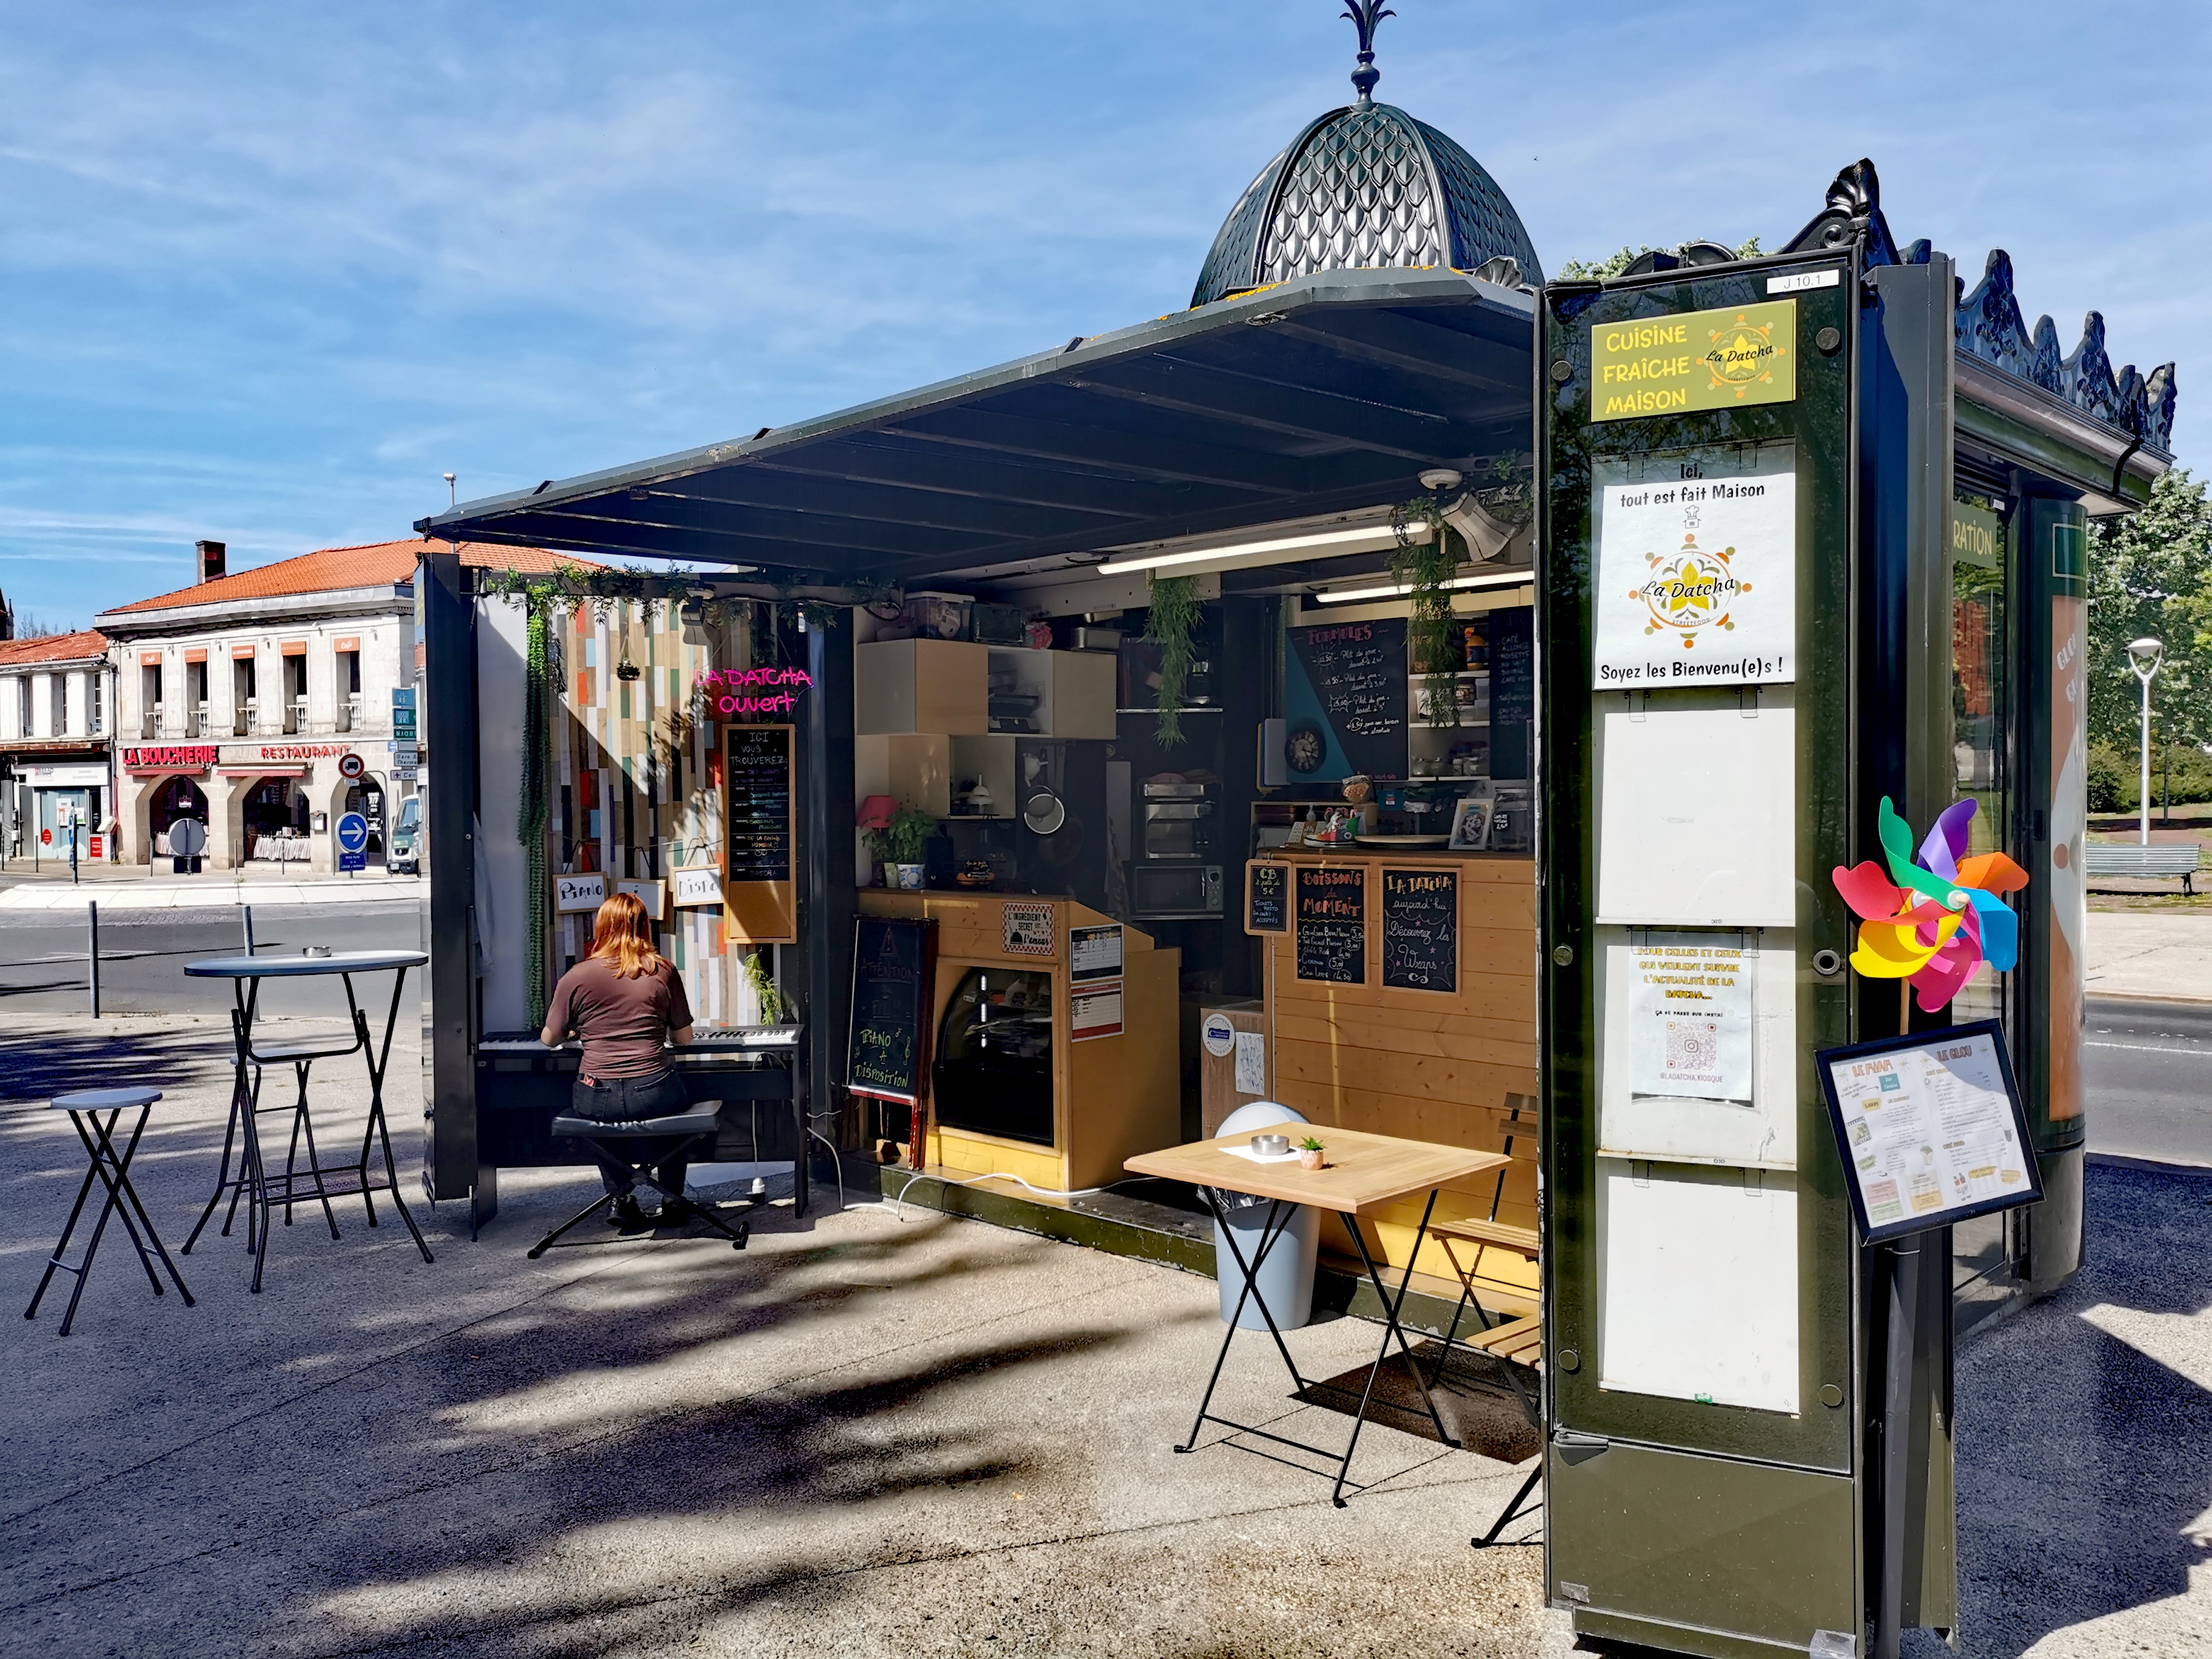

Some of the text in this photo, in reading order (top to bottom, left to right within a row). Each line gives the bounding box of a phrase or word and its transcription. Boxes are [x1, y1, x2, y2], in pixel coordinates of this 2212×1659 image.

[1783, 275, 1821, 289] J 10.1
[1705, 344, 1774, 363] La Datcha
[1603, 355, 1691, 384] FRAÎCHE
[1680, 463, 1703, 479] Ici,
[1620, 483, 1765, 507] tout est fait Maison
[1641, 577, 1735, 598] La Datcha
[1672, 617, 1710, 626] STREETFOOD
[1307, 624, 1372, 646] FORMULES
[695, 666, 811, 686] LA DATCHA
[1601, 665, 1640, 683] Soyez
[1647, 663, 1666, 678] les
[1672, 658, 1771, 678] Bienvenu(e)s
[122, 746, 217, 763] LA BOUCHERIE
[261, 745, 349, 758] RESTAURANT
[1260, 868, 1277, 879] CB
[1386, 875, 1452, 894] LA DATCHA
[1303, 897, 1361, 917] MOMENT
[1019, 922, 1033, 931] SECRET
[1388, 920, 1449, 945] Découvrez les
[1024, 934, 1049, 945] l'amour
[1398, 944, 1437, 976] Wraps
[1638, 947, 1741, 958] POUR CELLES ET CEUX
[1639, 961, 1740, 973] QUI VEULENT SUIVRE
[1644, 974, 1705, 985] L'ACTUALITÉ
[1721, 977, 1735, 986] LA
[1937, 1050, 1949, 1062] LE
[1852, 1065, 1865, 1078] LE
